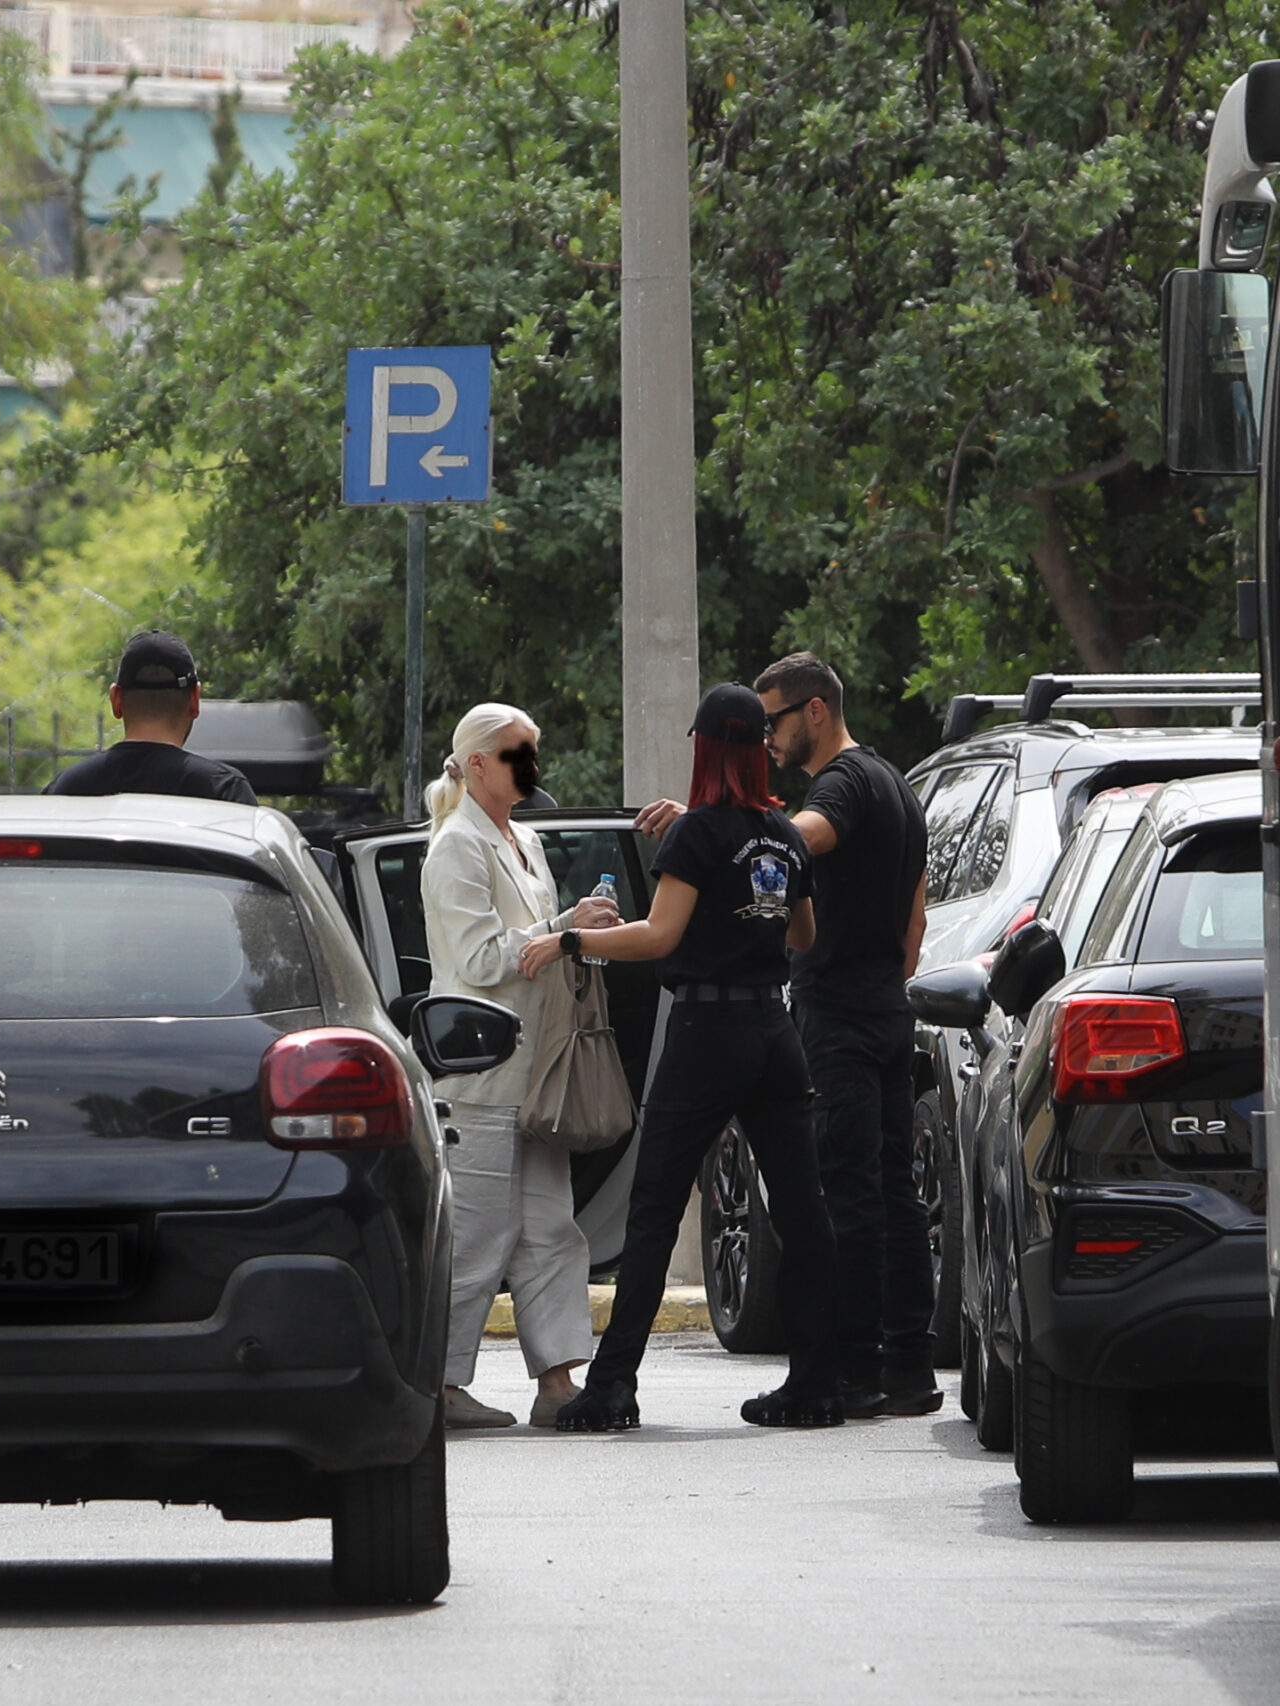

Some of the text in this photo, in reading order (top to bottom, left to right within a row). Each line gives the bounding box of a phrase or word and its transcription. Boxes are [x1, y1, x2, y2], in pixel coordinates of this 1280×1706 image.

[369, 365, 458, 487] P
[187, 1116, 232, 1135] C3
[1171, 1116, 1226, 1135] Q2
